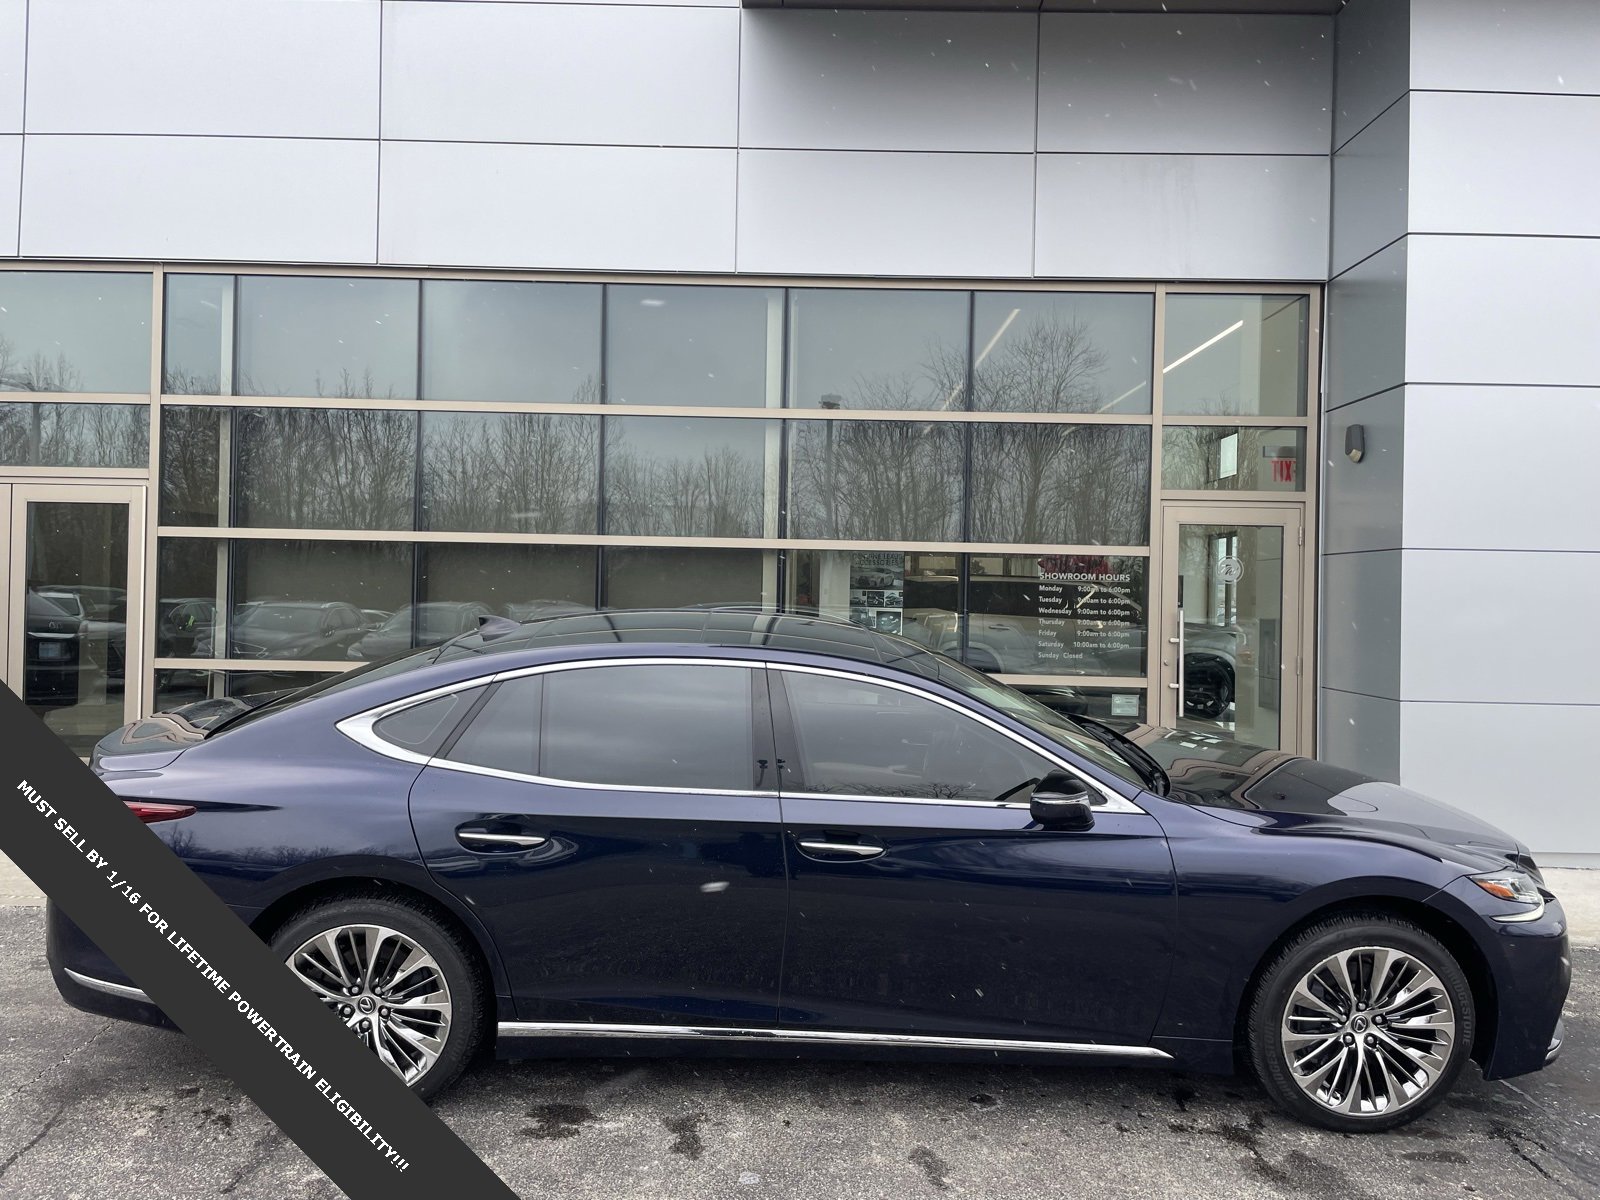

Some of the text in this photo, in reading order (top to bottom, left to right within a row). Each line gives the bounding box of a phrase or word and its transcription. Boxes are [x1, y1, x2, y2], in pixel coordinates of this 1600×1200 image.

[1039, 572, 1131, 581] SHOWROOM HOURS
[1039, 585, 1063, 593] Monday
[1039, 596, 1063, 604] Tuesday
[1039, 608, 1072, 616] Wednesday
[1039, 618, 1066, 626] Thursday
[1108, 620, 1130, 628] 6:00pm
[1038, 641, 1065, 649] Saturday
[1107, 642, 1130, 650] 6:00pm
[1038, 652, 1060, 660] Sunday
